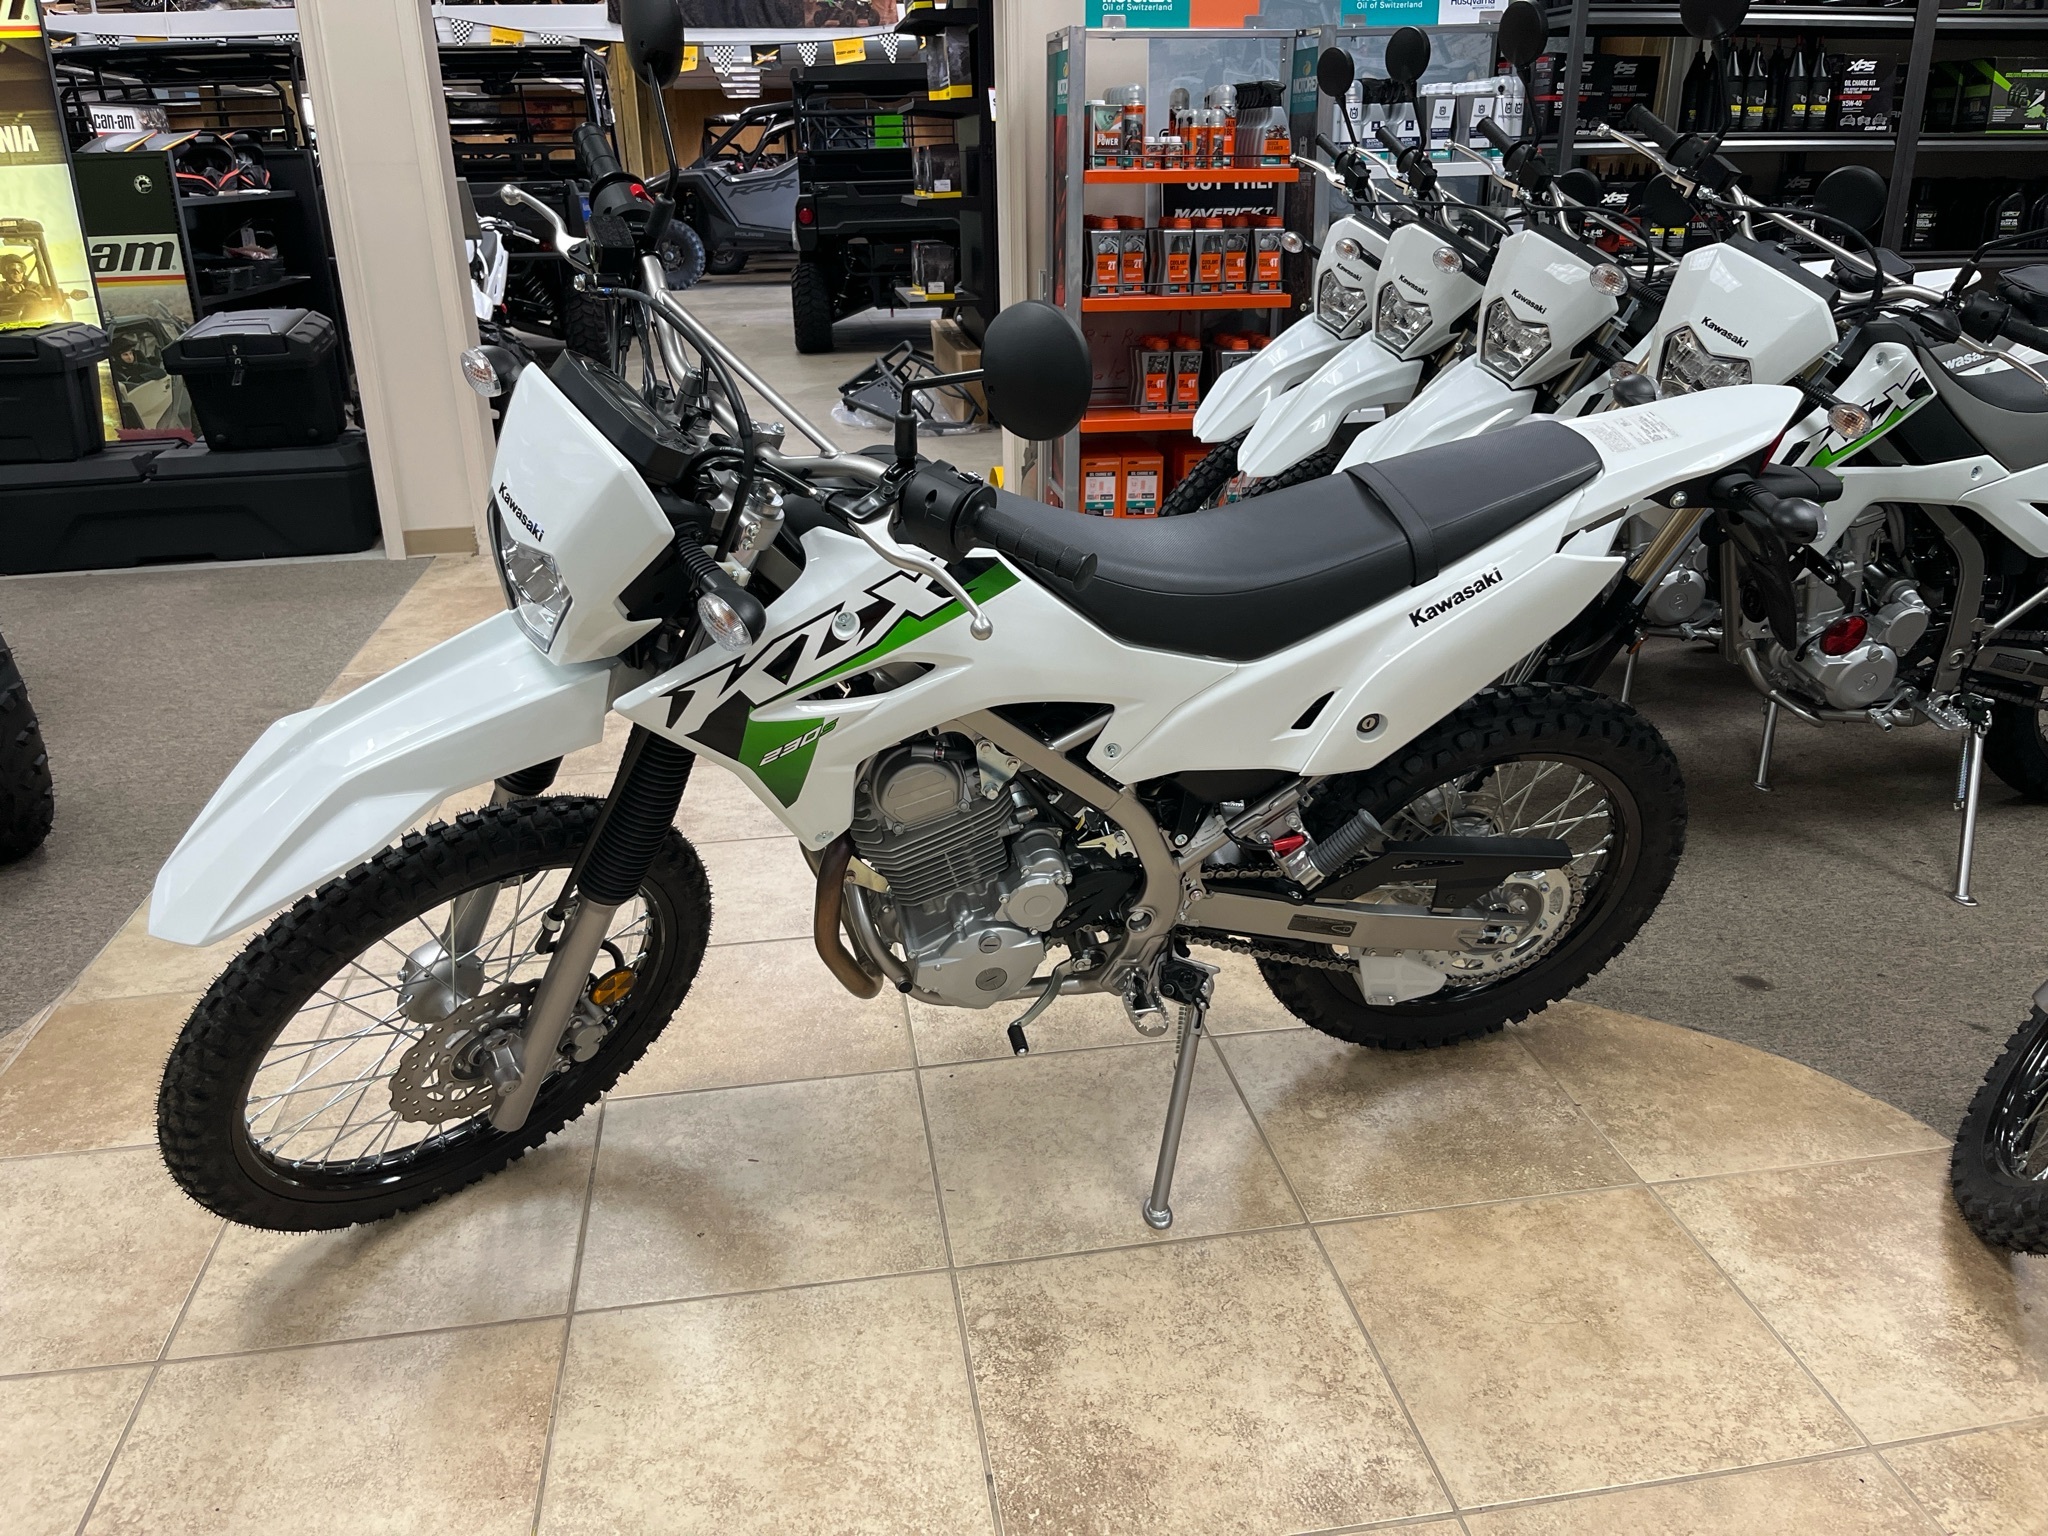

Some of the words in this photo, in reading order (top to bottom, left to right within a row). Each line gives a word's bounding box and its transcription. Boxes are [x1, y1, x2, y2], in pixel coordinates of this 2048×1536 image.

[1102, 3, 1114, 11] Oil
[1115, 3, 1124, 11] of
[1126, 3, 1173, 11] Switzerland
[1356, 1, 1367, 9] Oil
[1369, 1, 1377, 9] of
[1379, 1, 1423, 9] Switzerland
[1847, 59, 1878, 71] XPS
[93, 113, 135, 130] can-am
[727, 178, 798, 199] RZR
[1601, 192, 1630, 203] XPS
[1336, 262, 1362, 282] Kawasaki
[1398, 274, 1428, 296] Kawasaki
[1511, 288, 1547, 315] Kawasaki
[1701, 316, 1749, 348] Kawasaki
[1942, 351, 1985, 370] wasa
[498, 481, 545, 543] Kawasaki
[1408, 566, 1504, 628] Kawasaki
